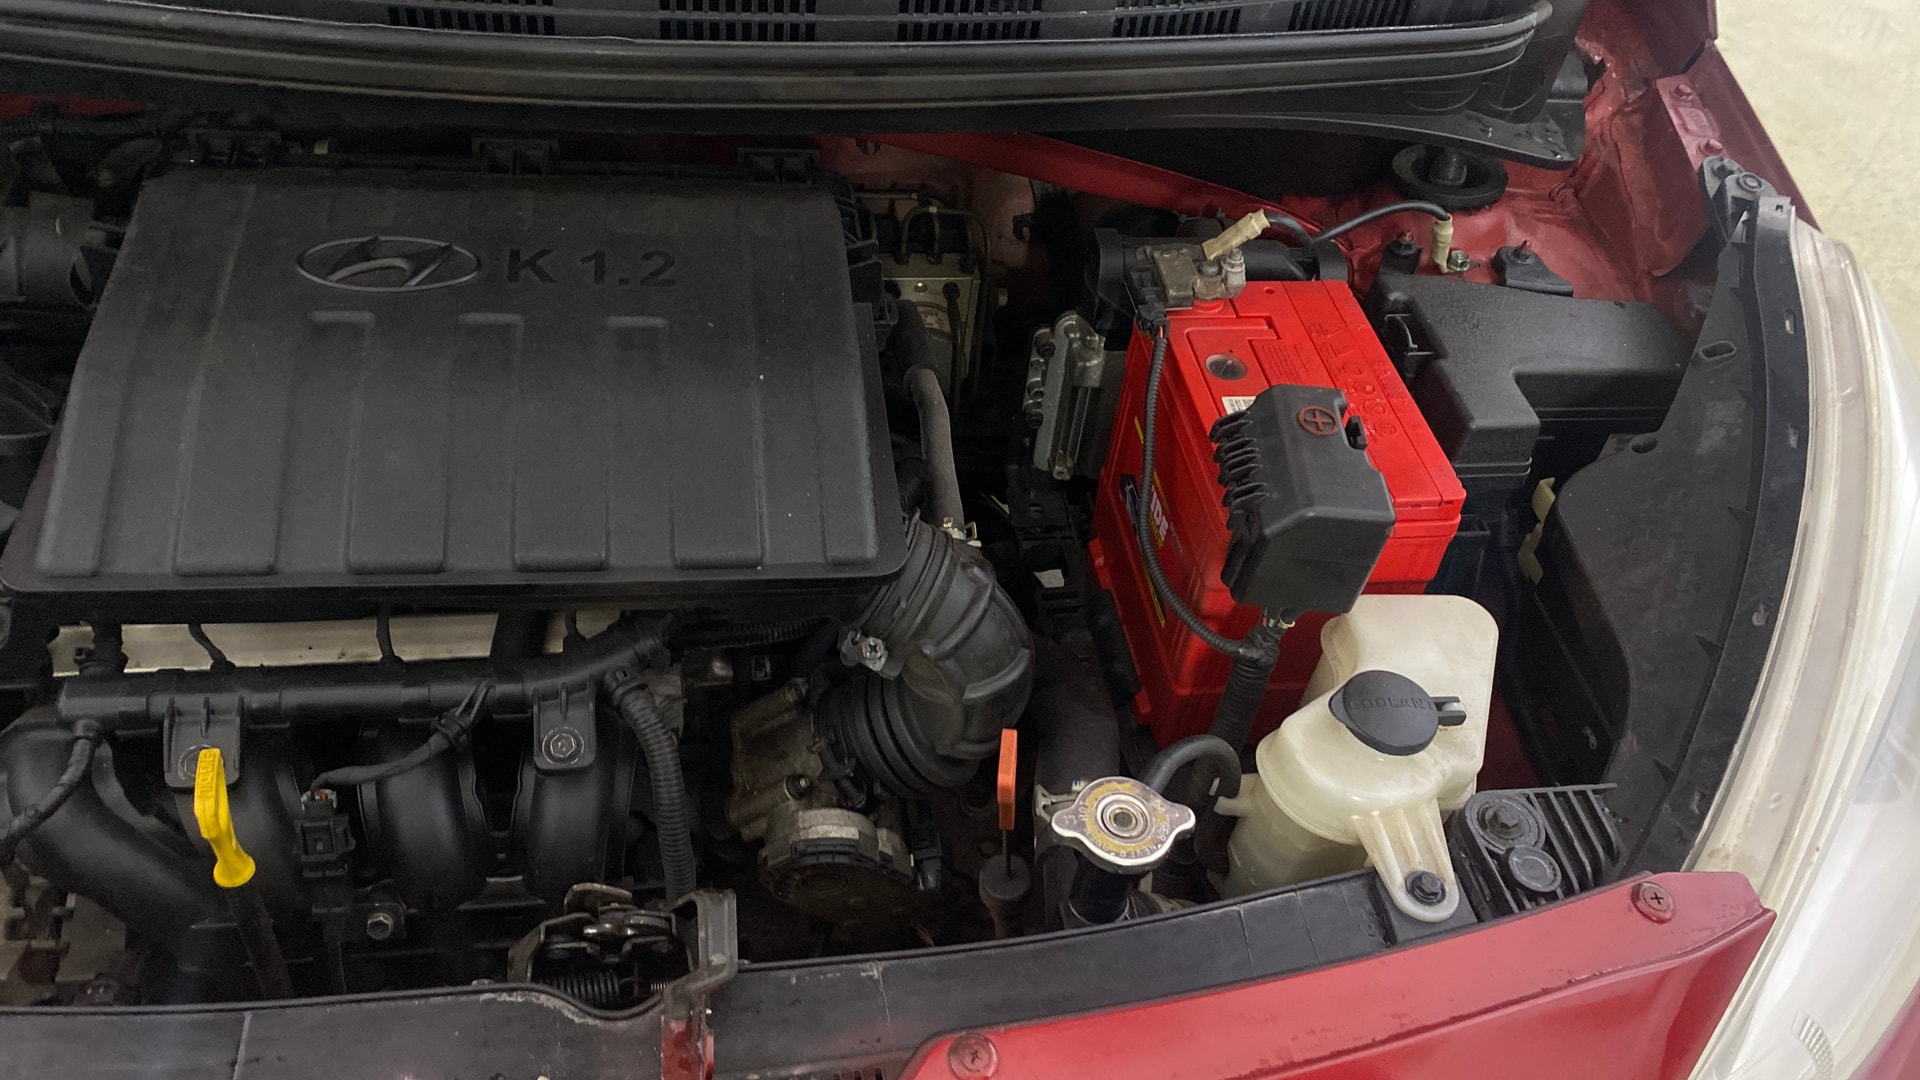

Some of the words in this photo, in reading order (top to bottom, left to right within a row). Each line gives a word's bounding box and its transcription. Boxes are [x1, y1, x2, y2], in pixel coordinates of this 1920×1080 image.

[507, 248, 557, 284] K
[581, 250, 677, 287] 1.2
[1350, 696, 1434, 710] COOLANT
